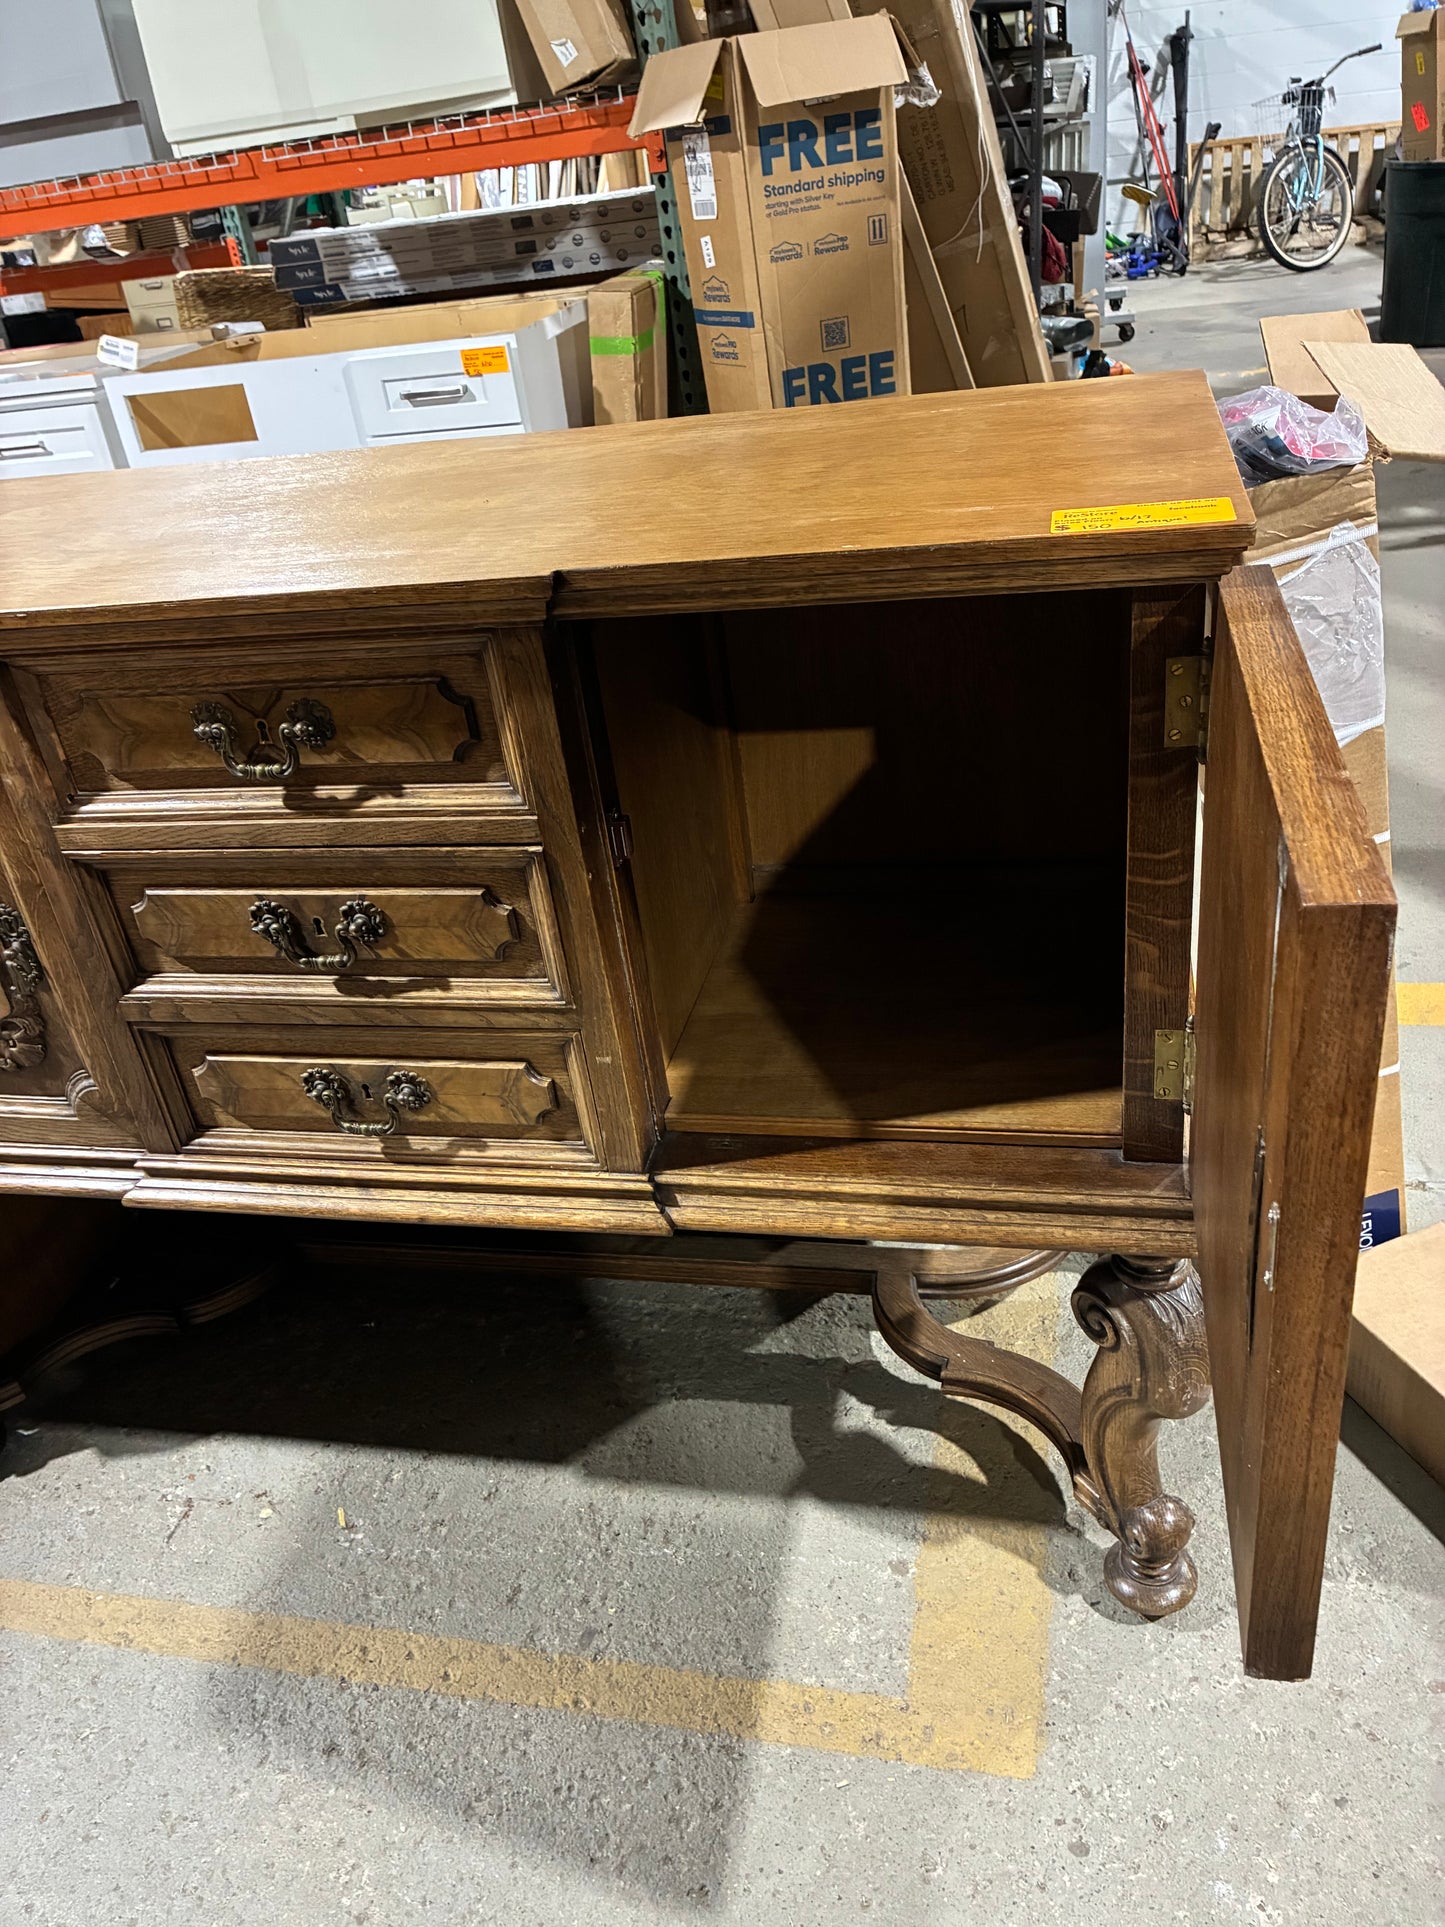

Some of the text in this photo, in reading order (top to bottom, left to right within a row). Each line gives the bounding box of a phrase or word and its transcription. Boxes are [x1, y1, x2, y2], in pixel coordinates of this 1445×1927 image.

[758, 108, 883, 176] FREE
[764, 168, 885, 198] Standard shipping
[804, 194, 822, 204] Silver
[814, 243, 849, 255] Rewards
[770, 252, 803, 263] Rewards
[703, 291, 731, 303] Rewards
[711, 348, 739, 361] Rewards
[782, 350, 896, 408] FREE
